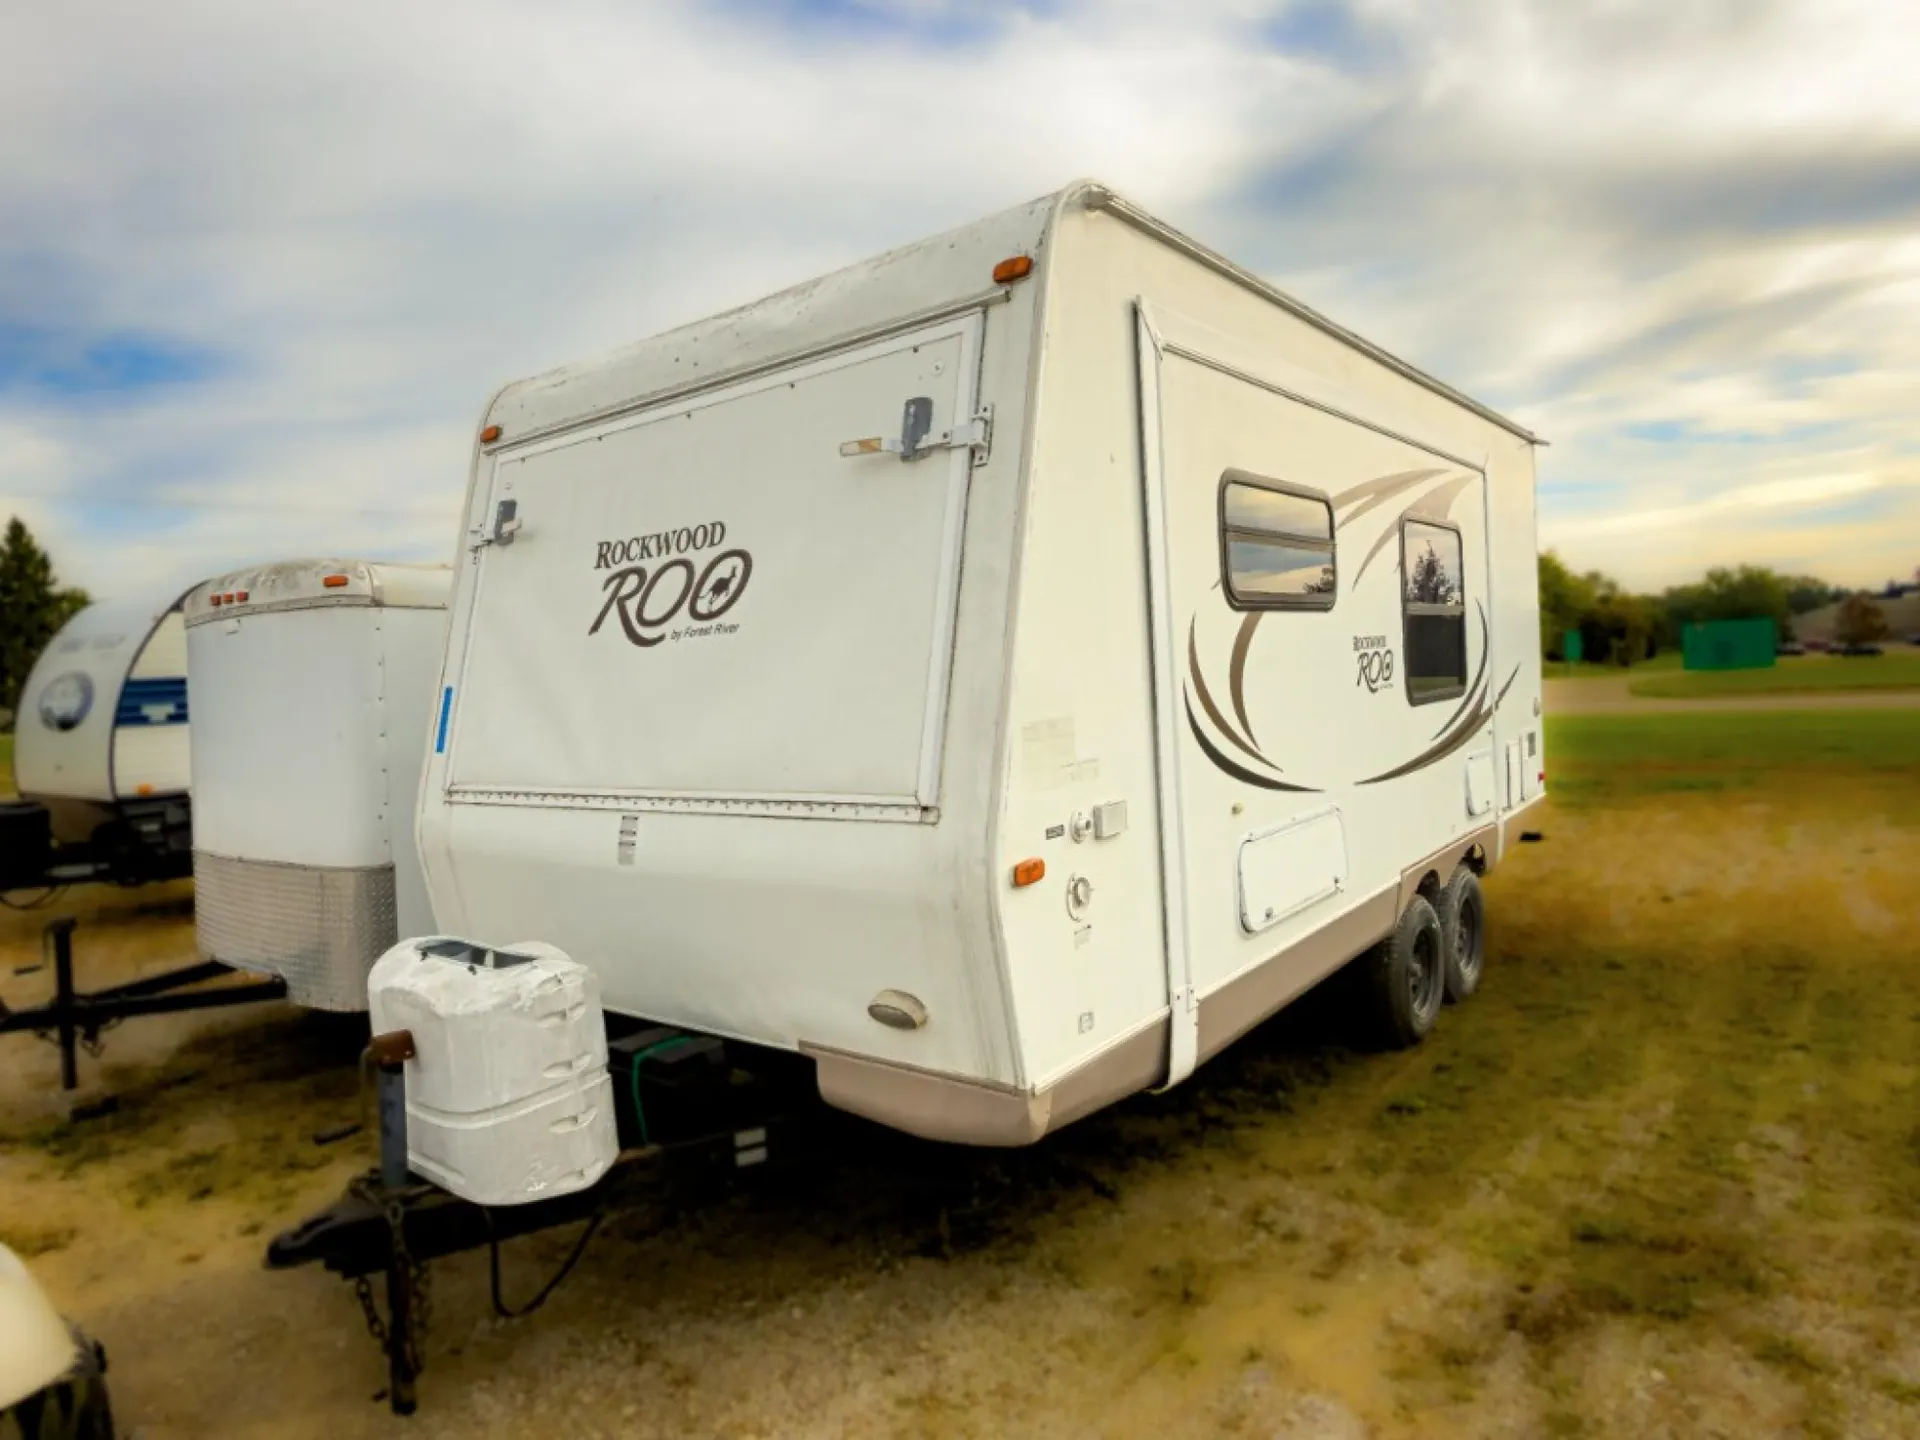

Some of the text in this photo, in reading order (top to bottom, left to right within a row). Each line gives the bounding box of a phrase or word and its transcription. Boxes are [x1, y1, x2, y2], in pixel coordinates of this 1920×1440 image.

[594, 521, 726, 570] ROCKWOOD
[588, 549, 753, 648] ROO
[671, 623, 740, 643] by Forest River
[1356, 649, 1394, 693] ROO
